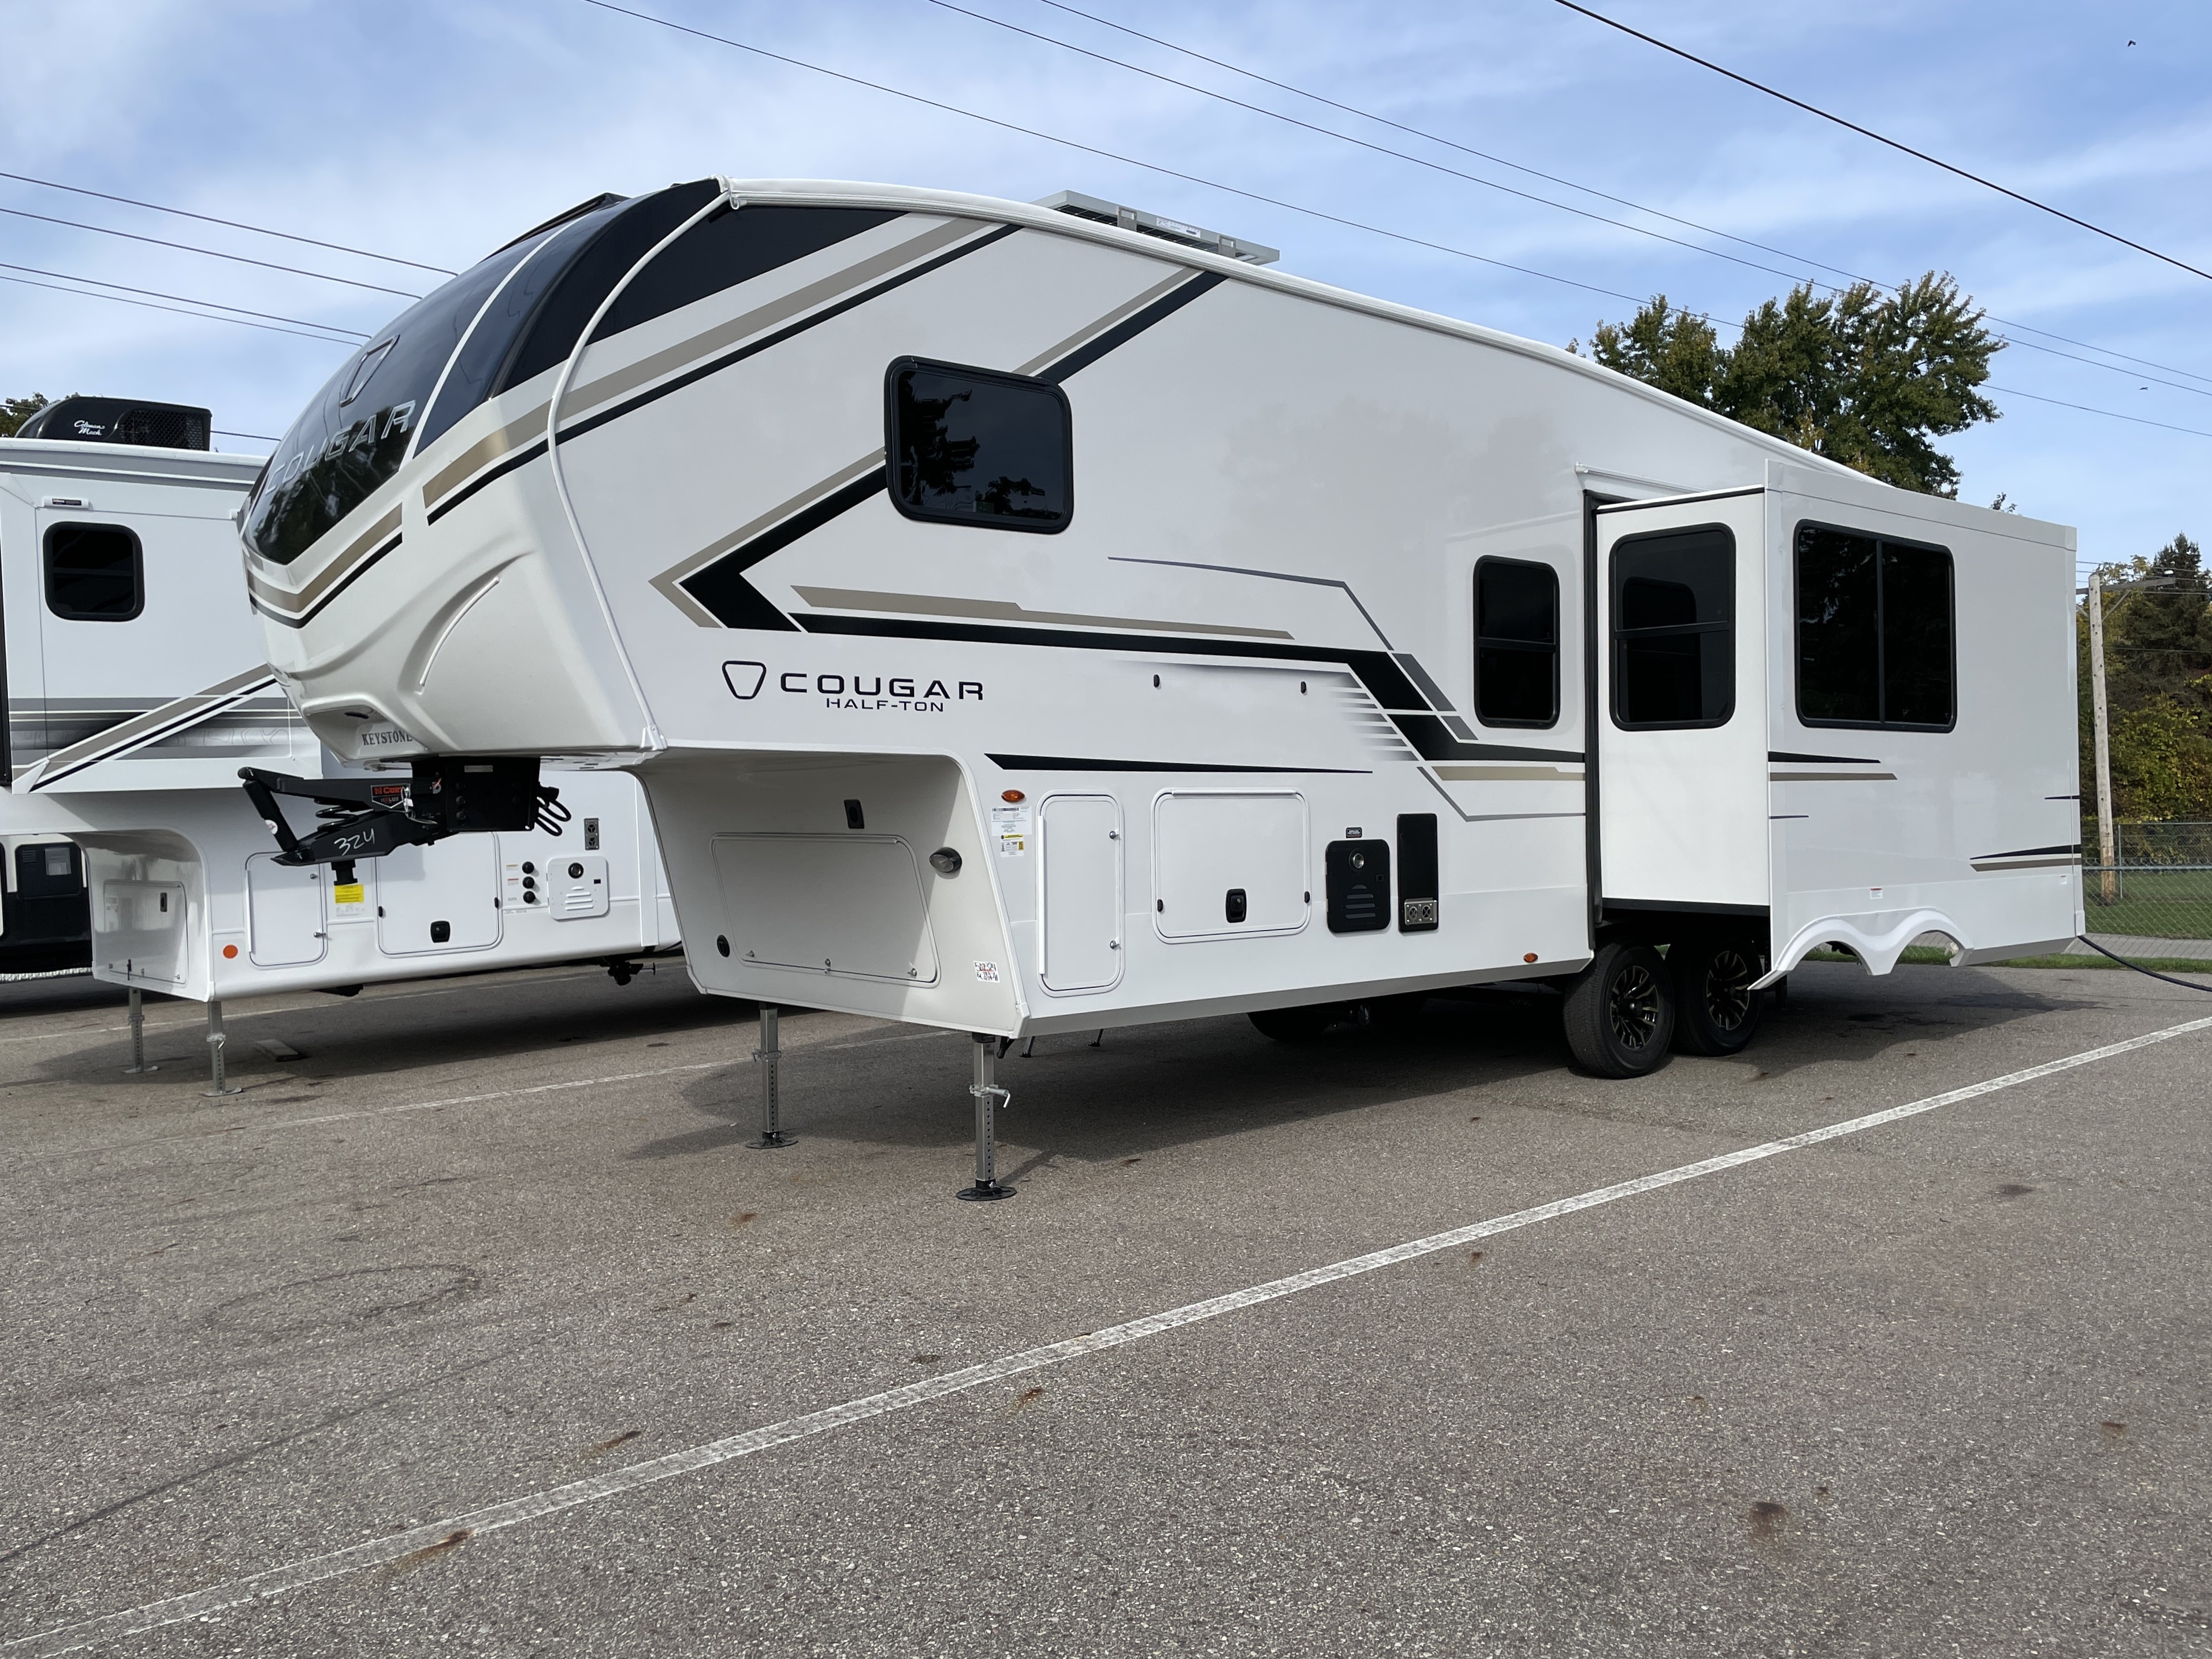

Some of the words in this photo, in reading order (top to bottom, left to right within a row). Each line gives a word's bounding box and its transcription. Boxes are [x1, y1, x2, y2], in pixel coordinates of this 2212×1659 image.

[265, 400, 416, 496] COUGAR
[780, 672, 983, 701] COUGAR
[826, 698, 943, 712] HALF-TON
[334, 828, 374, 856] 324
